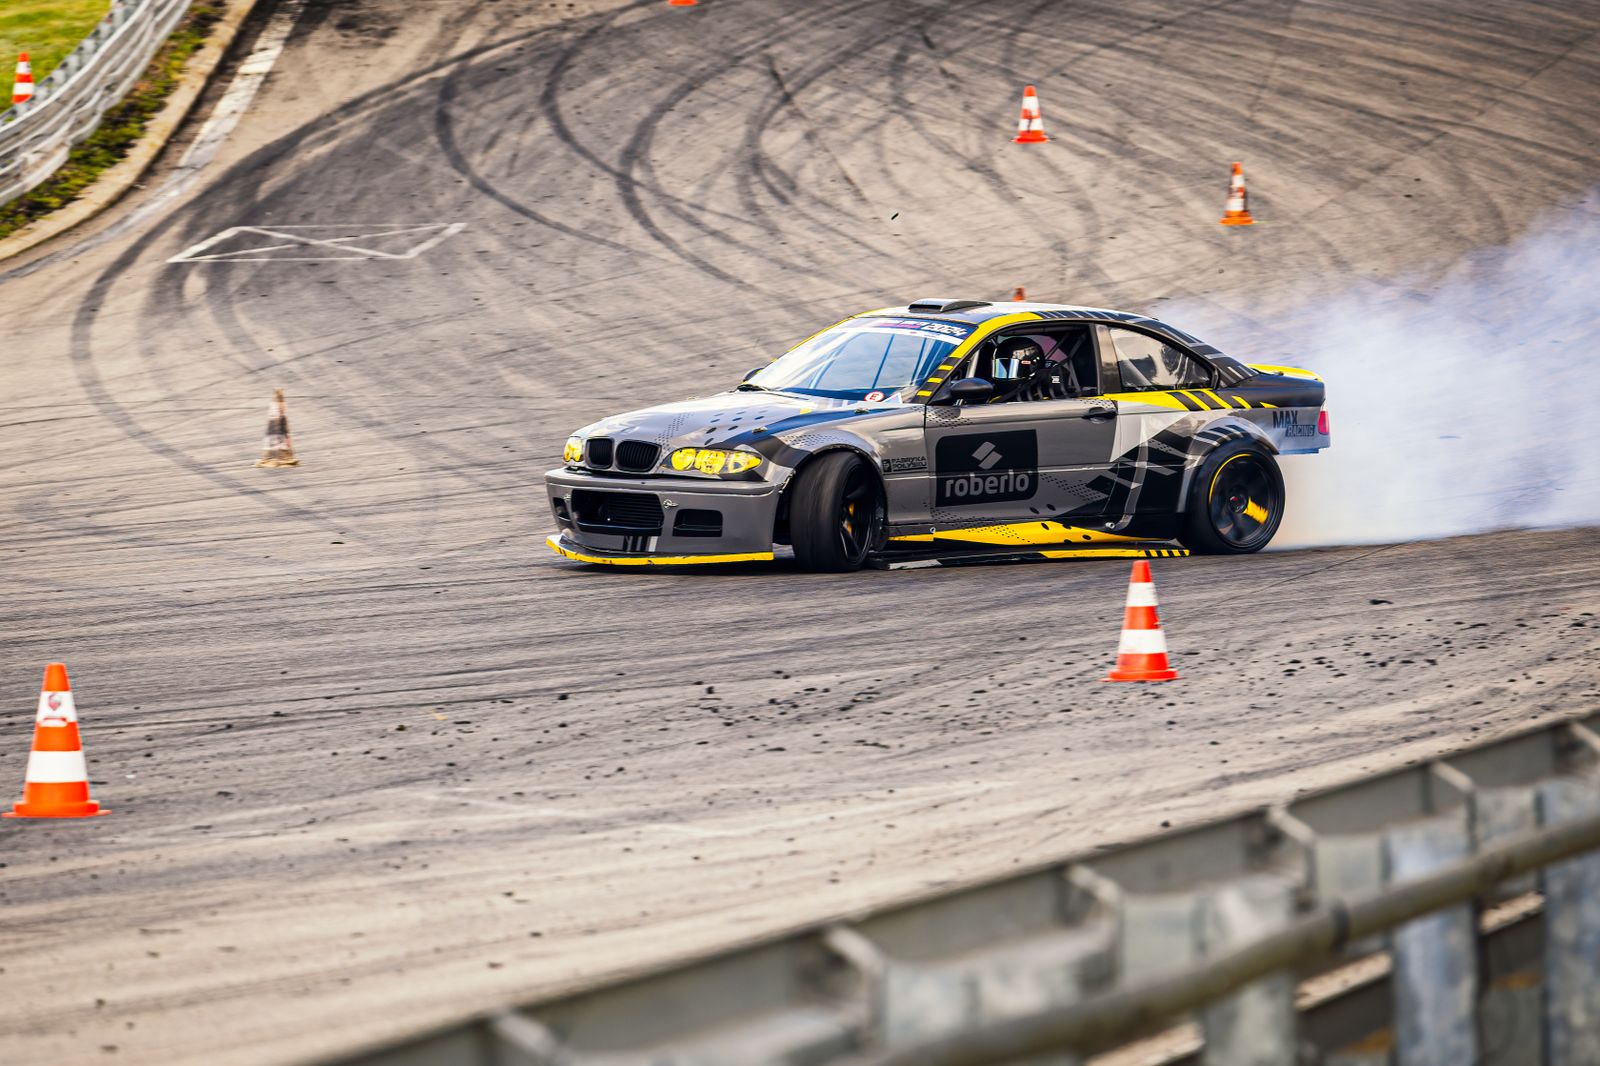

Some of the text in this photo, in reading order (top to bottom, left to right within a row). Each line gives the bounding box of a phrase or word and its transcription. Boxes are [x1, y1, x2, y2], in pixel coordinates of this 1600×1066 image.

[1272, 411, 1298, 428] MAX
[1286, 425, 1315, 436] RACING
[944, 469, 1030, 498] roberlo
